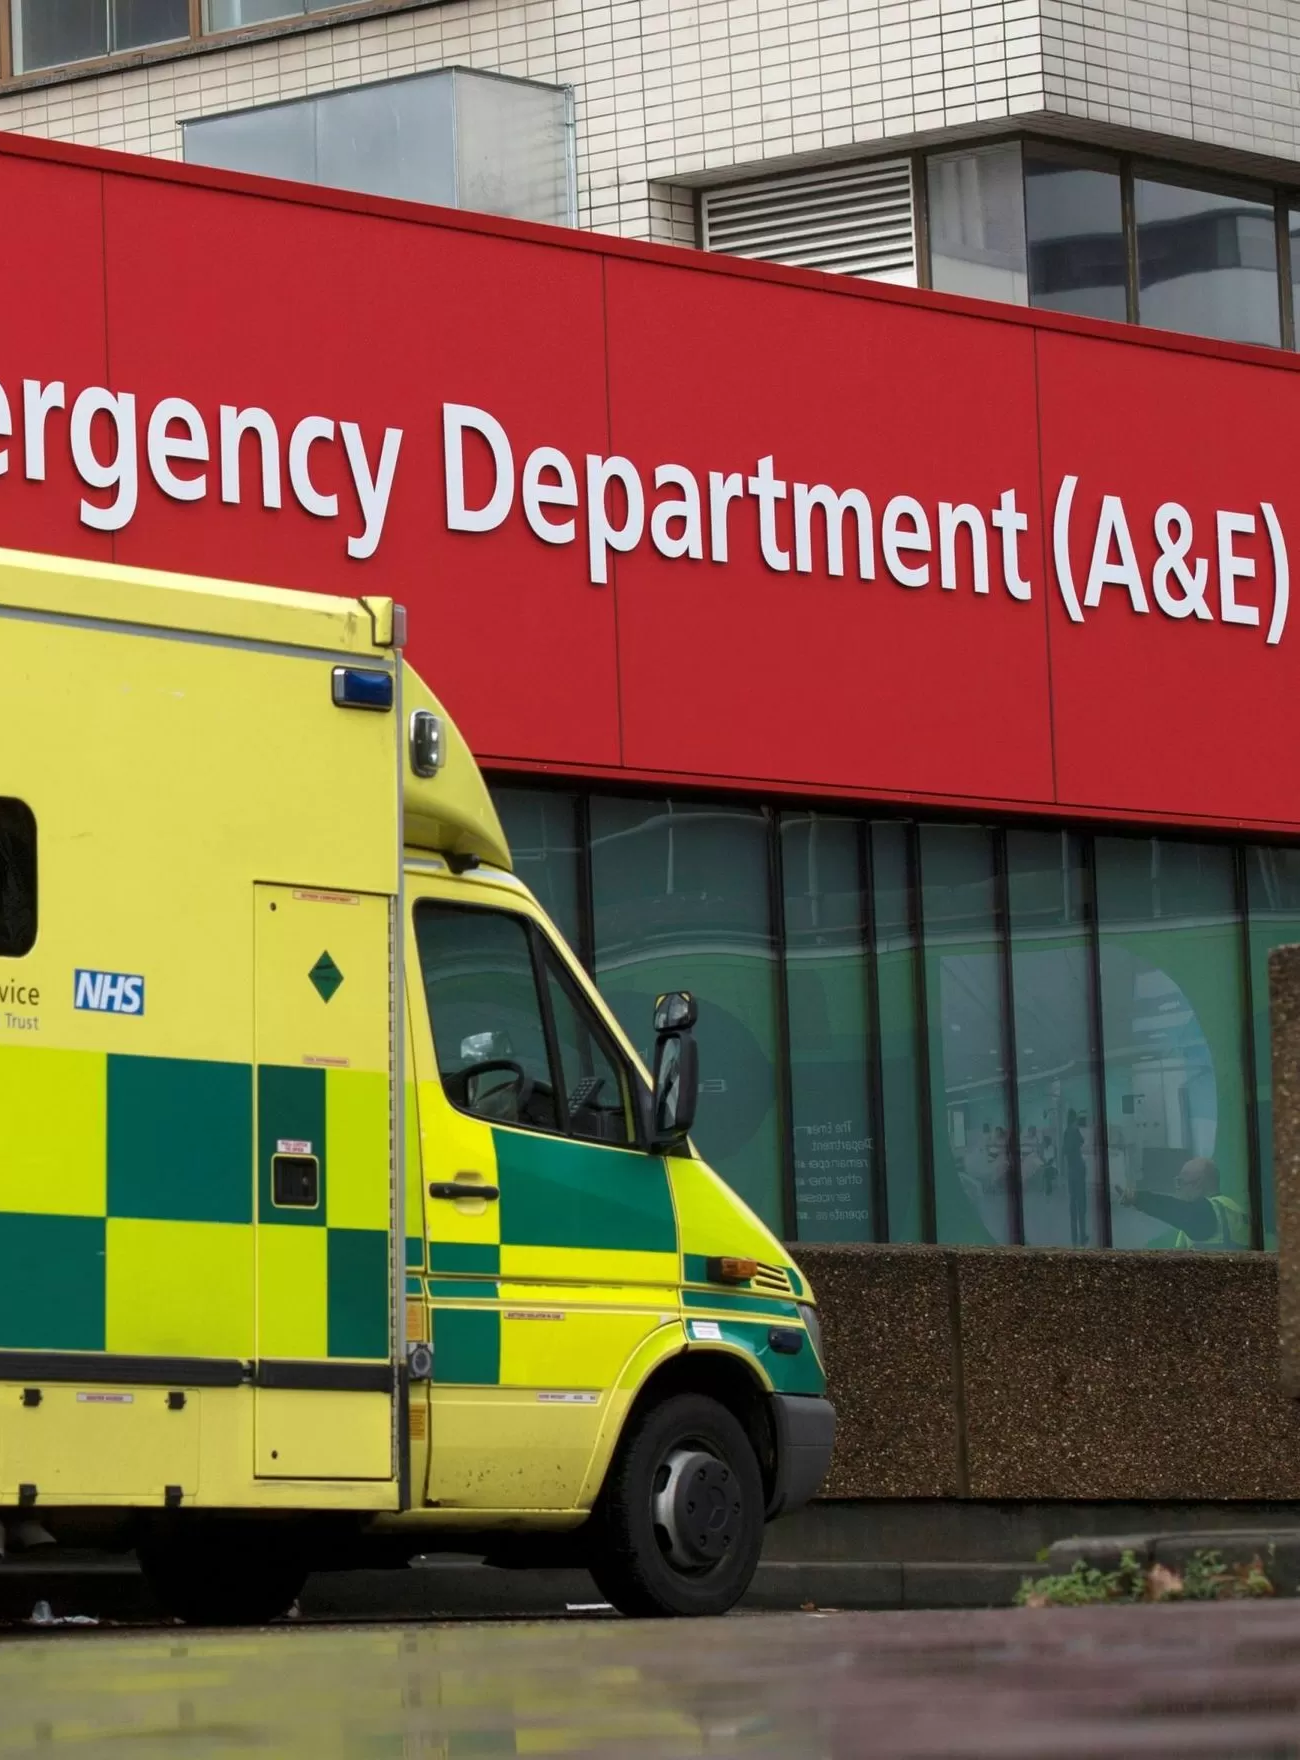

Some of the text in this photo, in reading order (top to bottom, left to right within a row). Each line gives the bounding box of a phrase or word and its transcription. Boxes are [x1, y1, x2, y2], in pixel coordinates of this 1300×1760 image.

[442, 402, 1033, 601] Department
[1052, 475, 1290, 645] (A&E)
[75, 971, 143, 1014] NHS
[4, 1012, 40, 1031] Trust
